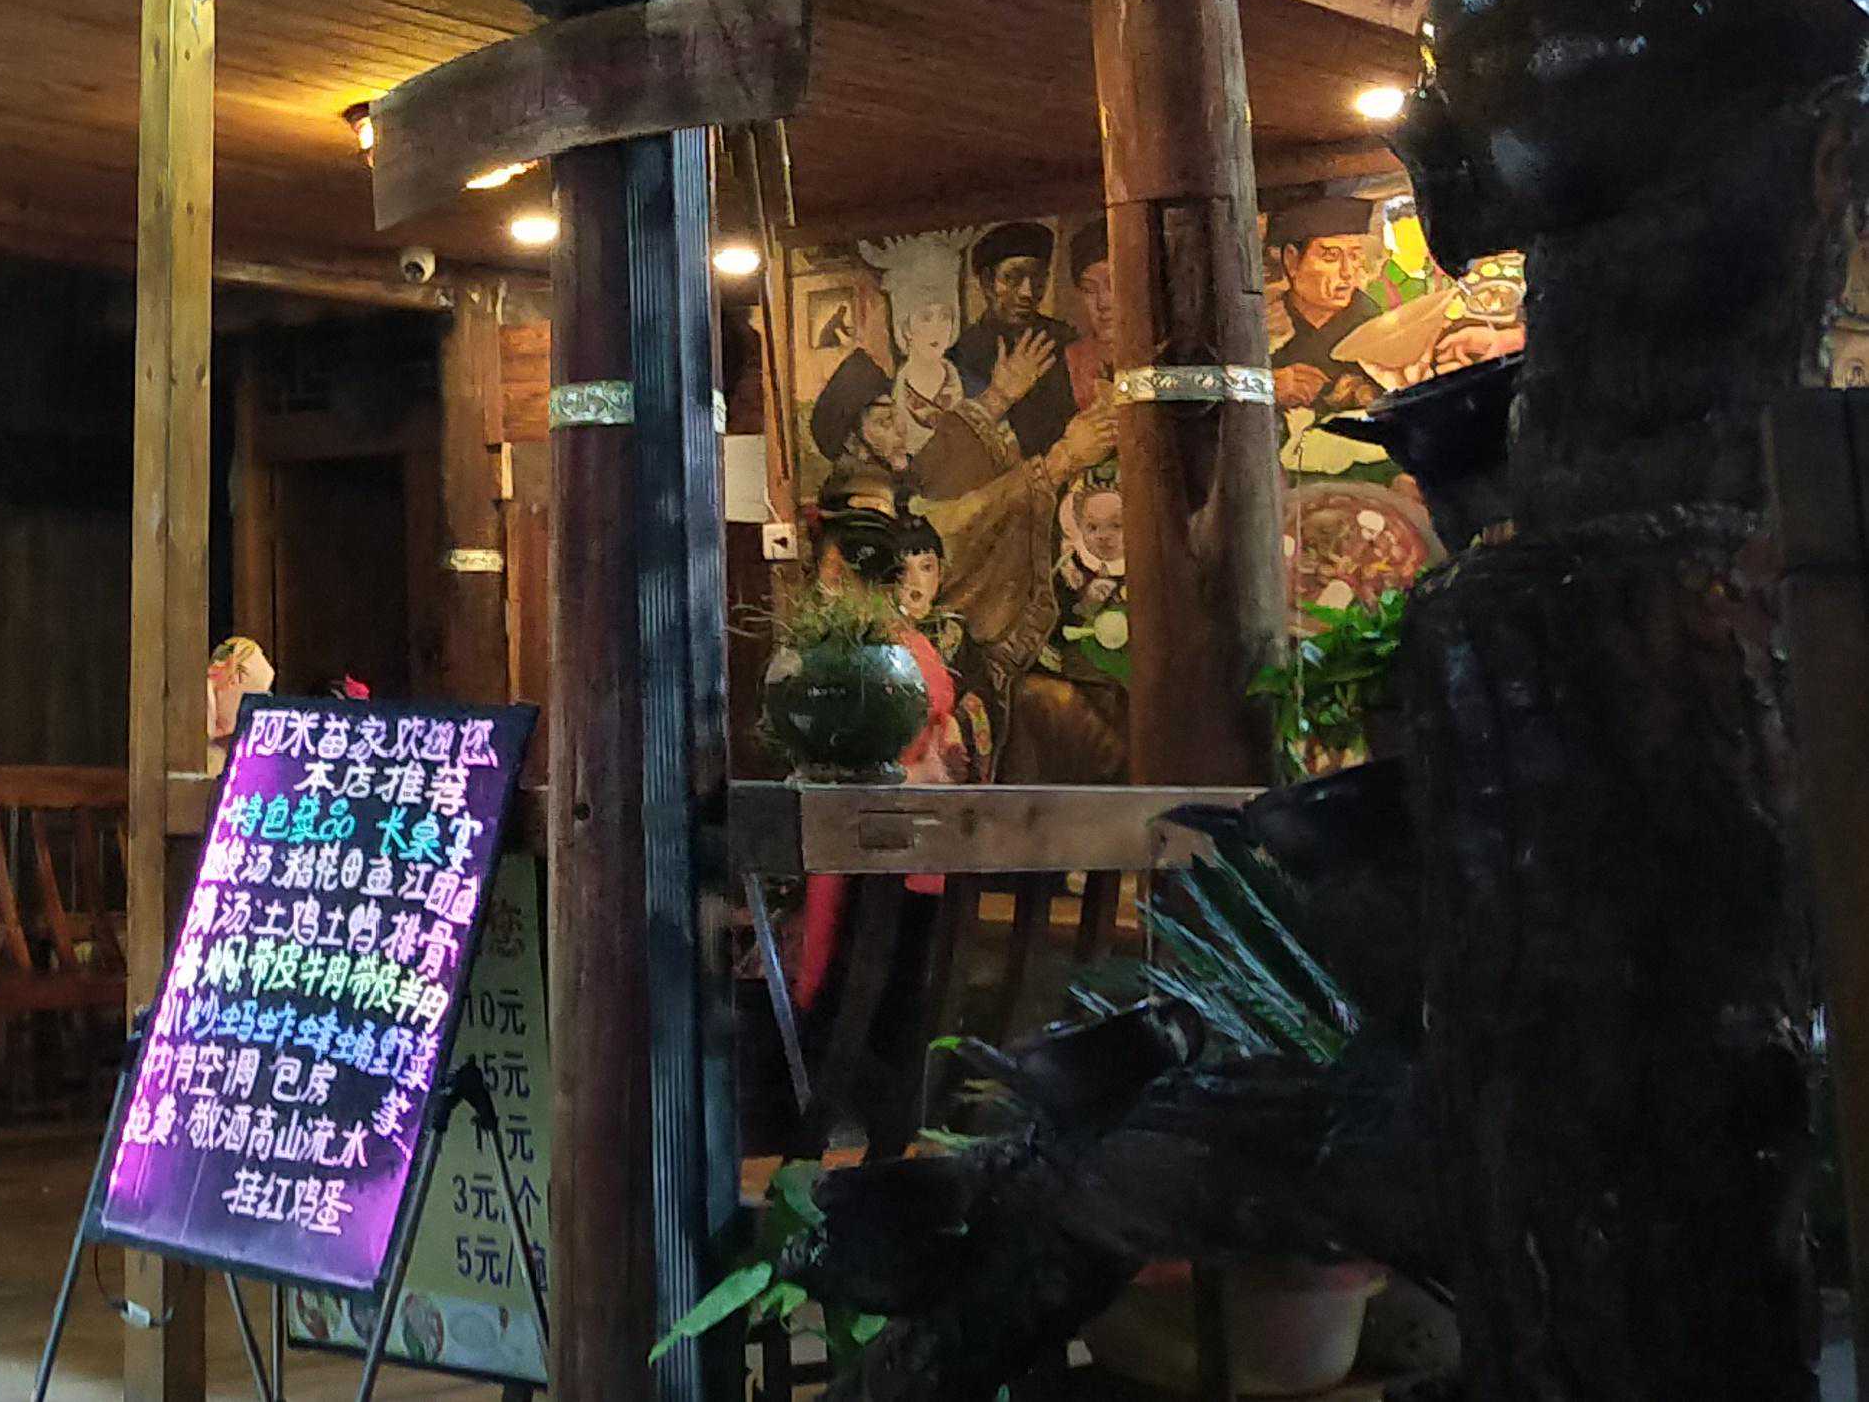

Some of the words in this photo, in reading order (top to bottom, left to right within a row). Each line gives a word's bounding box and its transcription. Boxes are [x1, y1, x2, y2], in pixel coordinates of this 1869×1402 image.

[245, 708, 498, 768] 阿米苗家欢迎您
[293, 760, 470, 816] 本店推荐
[222, 792, 356, 842] 特色菜品
[268, 1051, 338, 1106] 包房
[221, 1165, 354, 1236] 挂红鸡蛋
